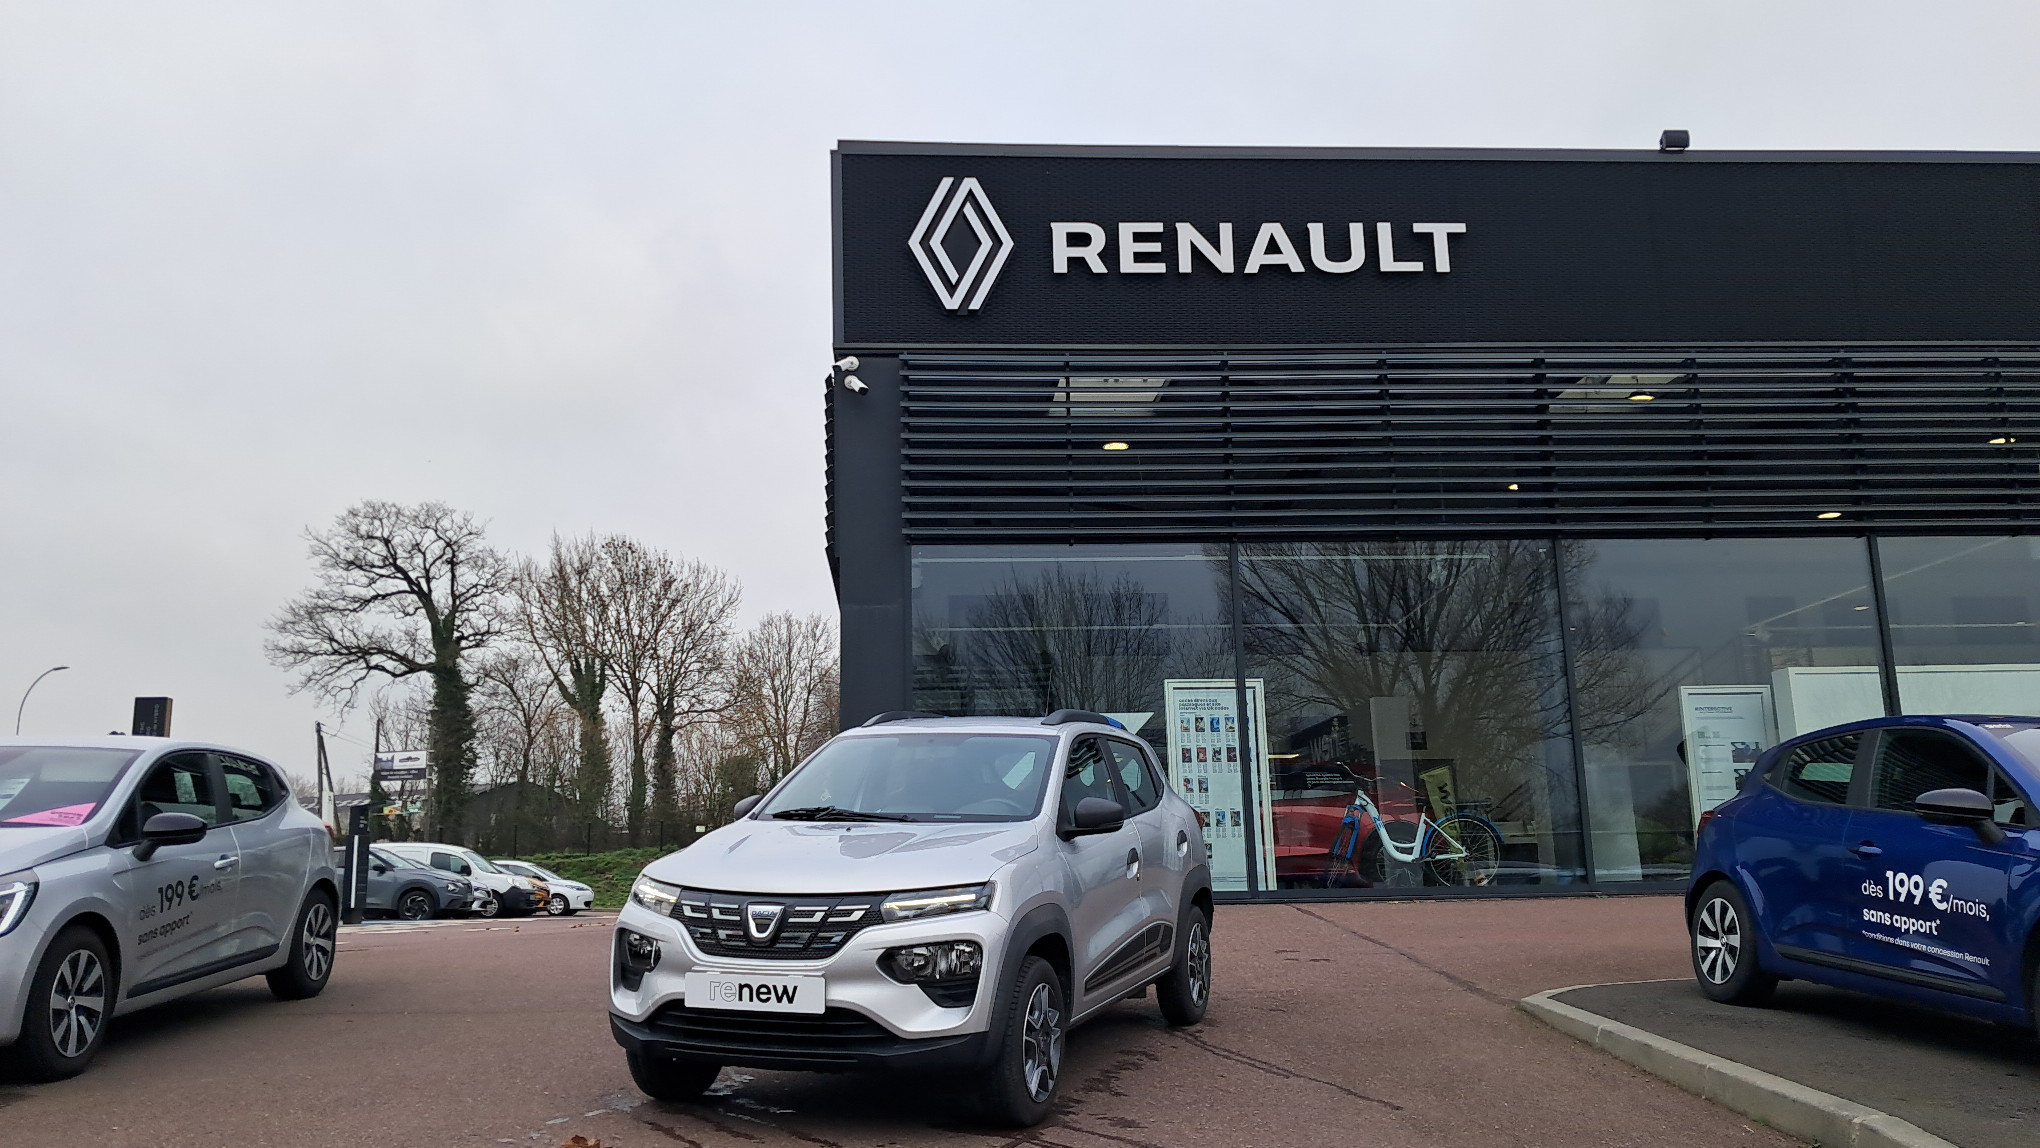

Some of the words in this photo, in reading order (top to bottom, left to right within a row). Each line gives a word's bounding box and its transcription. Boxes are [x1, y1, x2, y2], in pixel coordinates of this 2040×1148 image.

[1050, 222, 1467, 274] RENAULT
[157, 880, 185, 914] 199
[1861, 879, 1884, 899] dès
[1886, 870, 1925, 906] 199
[1862, 908, 1892, 927] sans
[137, 928, 159, 946] sans
[1894, 937, 1911, 948] dans
[1910, 941, 1927, 952] votre
[1927, 945, 1964, 960] concession
[709, 980, 798, 1004] renew
